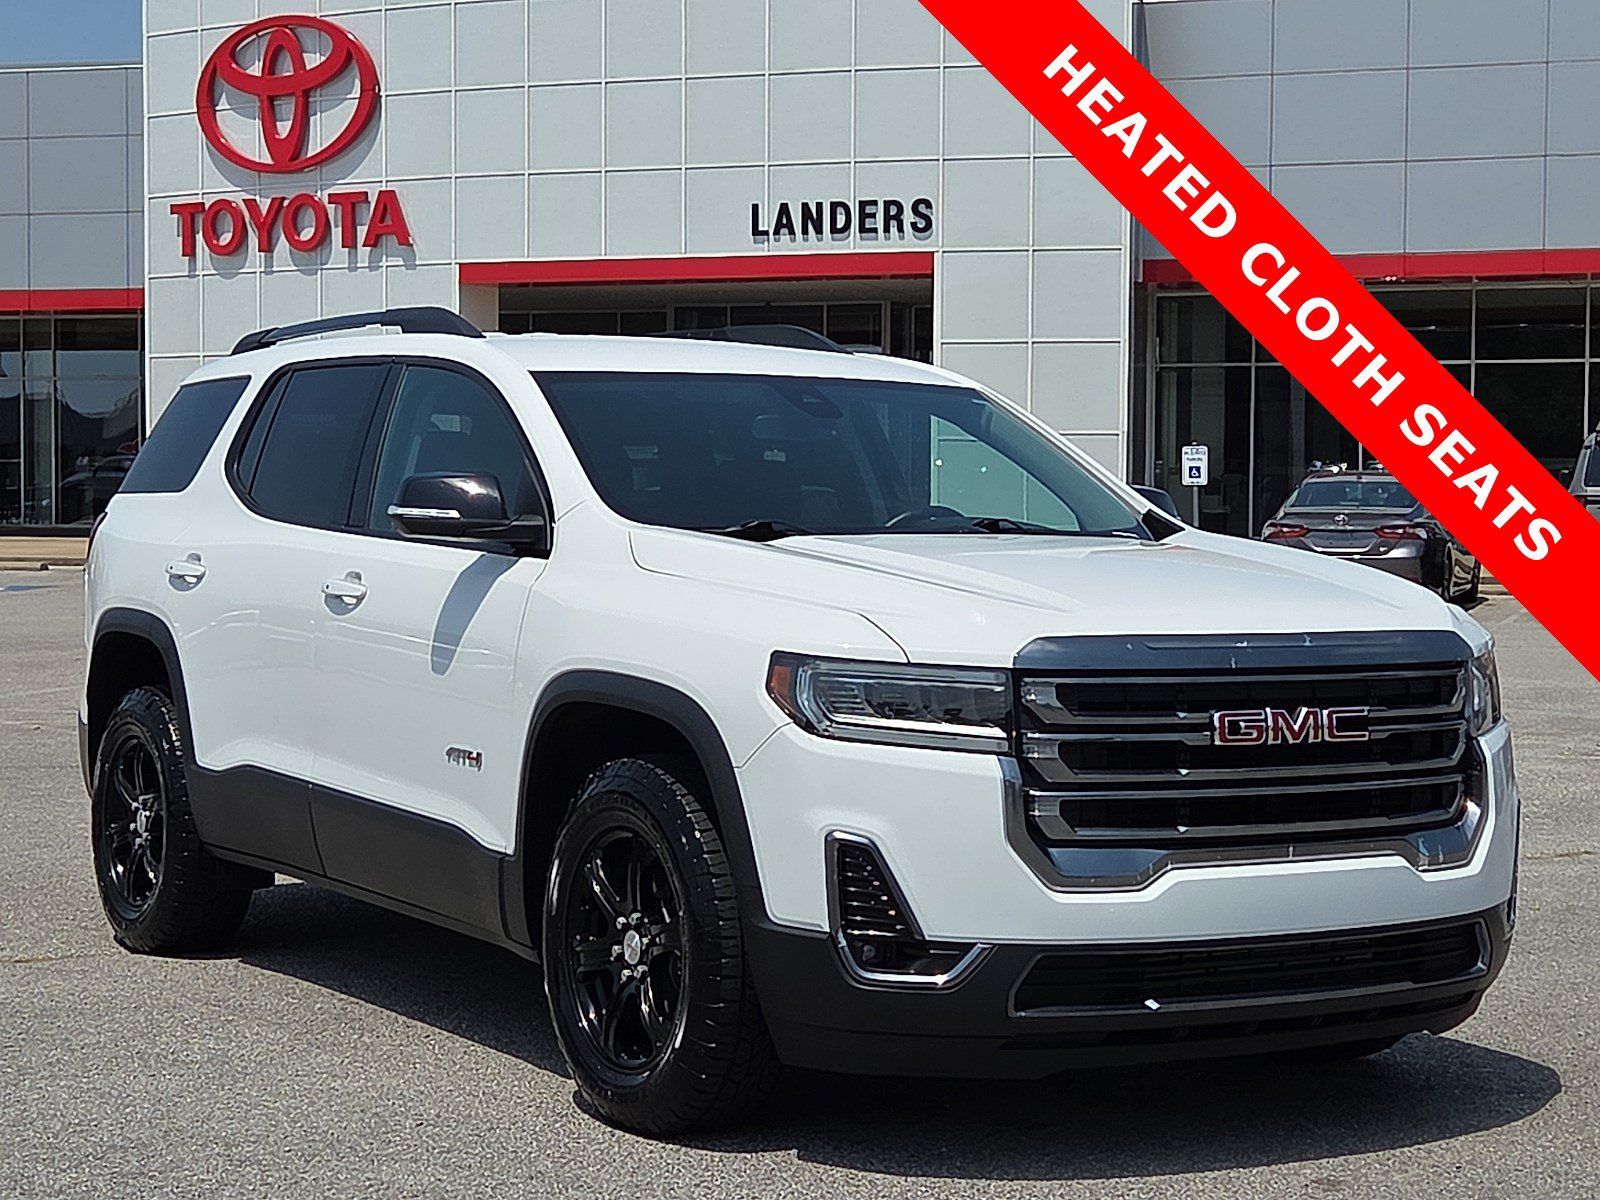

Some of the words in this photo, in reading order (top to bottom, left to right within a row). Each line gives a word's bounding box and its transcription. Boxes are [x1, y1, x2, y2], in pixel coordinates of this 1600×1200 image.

[170, 189, 413, 257] TOYOTA
[751, 198, 934, 237] LANDERS
[1213, 706, 1370, 746] GMC
